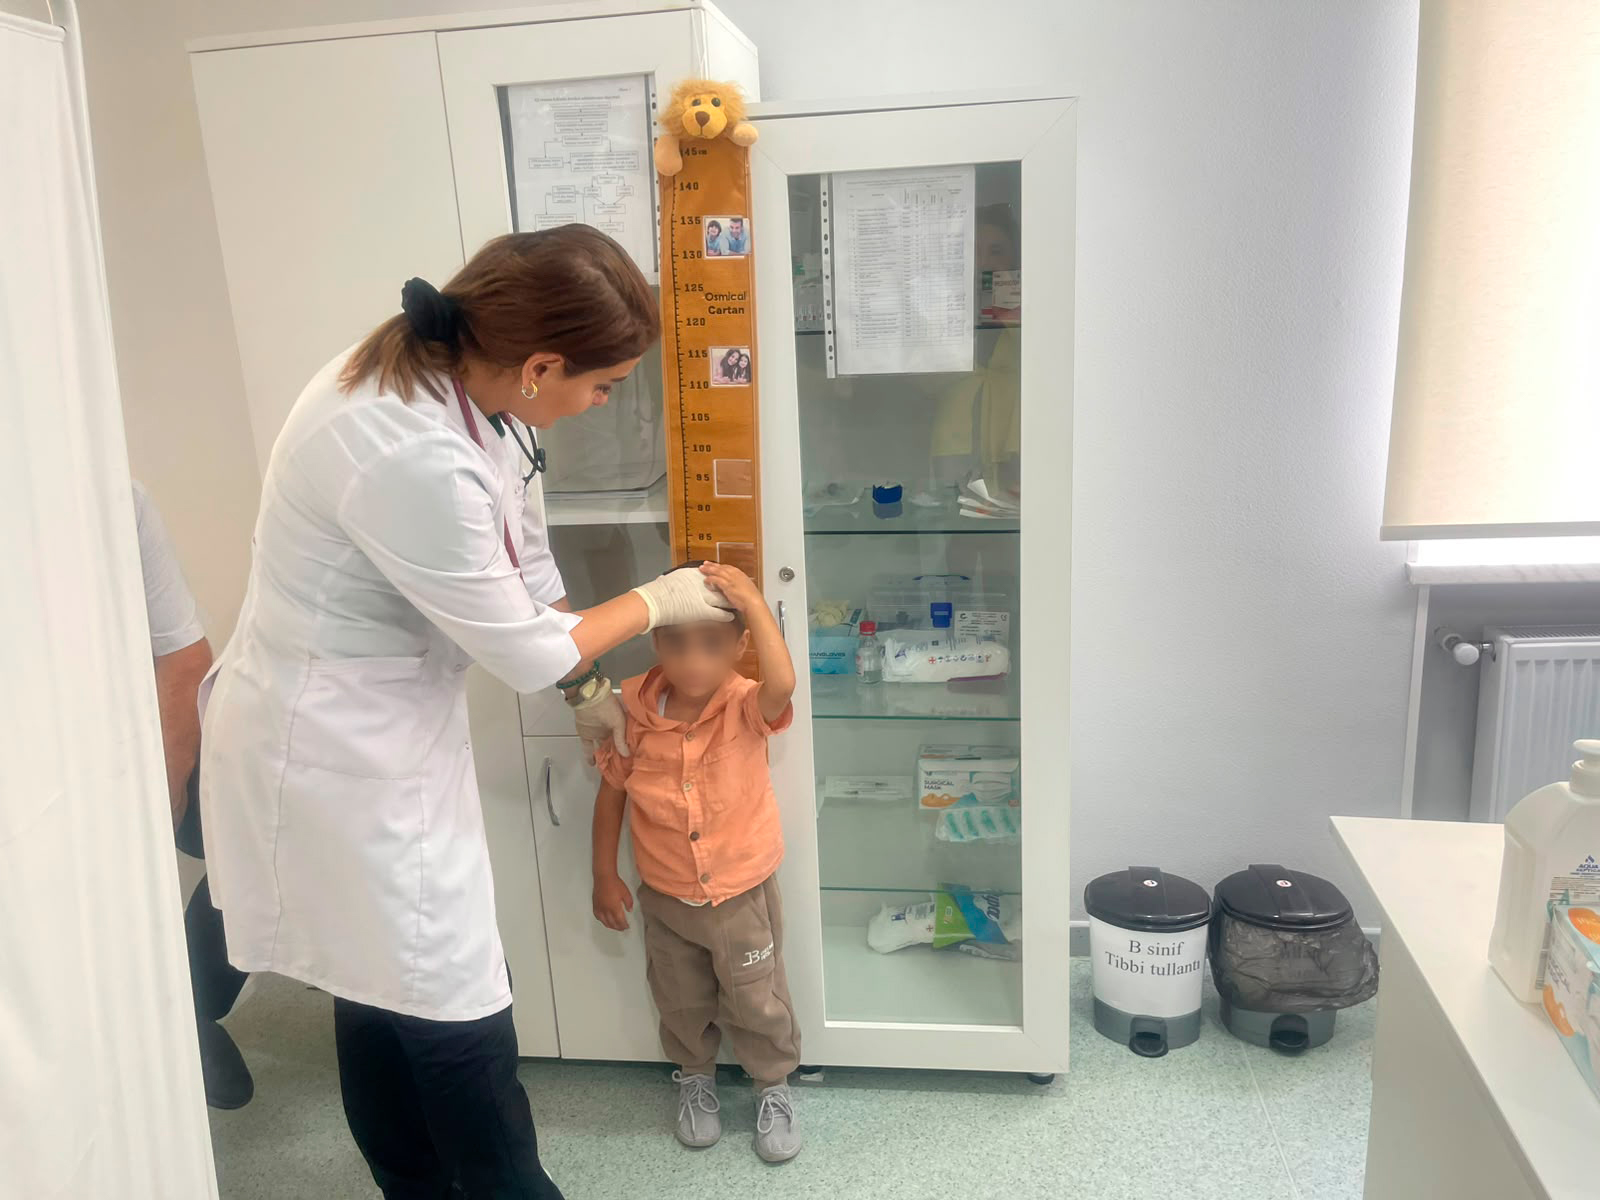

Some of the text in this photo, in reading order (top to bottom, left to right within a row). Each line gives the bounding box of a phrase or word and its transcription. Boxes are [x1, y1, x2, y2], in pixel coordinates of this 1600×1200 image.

[680, 182, 699, 191] 140
[681, 216, 701, 225] 135
[682, 250, 702, 259] 130
[684, 283, 704, 292] 125
[686, 317, 706, 327] 120
[688, 349, 708, 358] 115
[690, 381, 709, 389] 110
[691, 413, 710, 421] 105
[692, 444, 712, 453] 100
[696, 473, 710, 481] 95
[697, 504, 711, 512] 90
[698, 533, 712, 541] 85
[1129, 939, 1185, 956] B sinif
[1105, 951, 1145, 974] Tibbi
